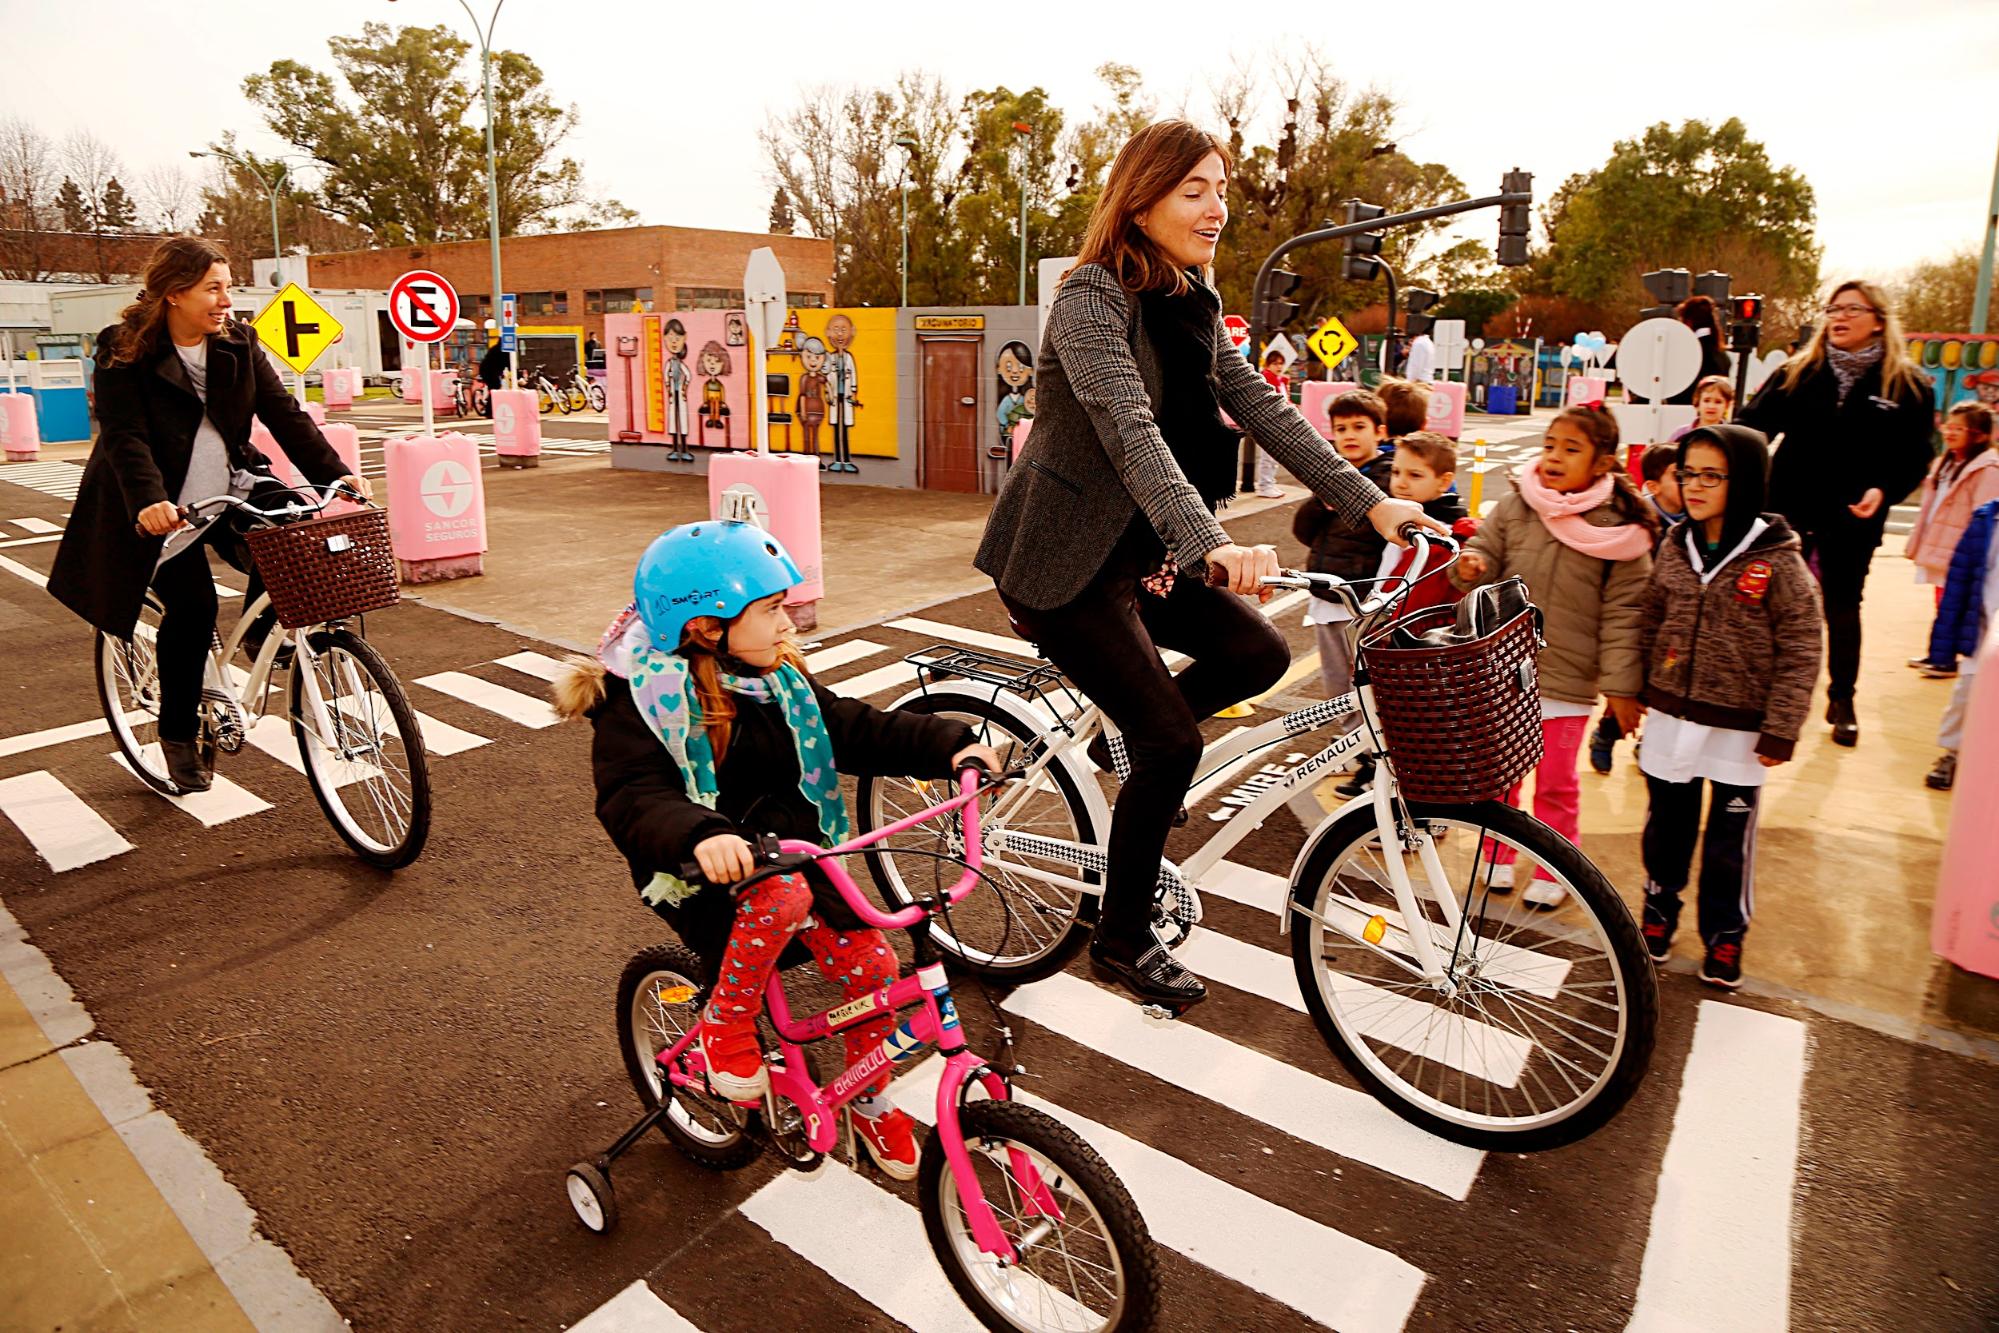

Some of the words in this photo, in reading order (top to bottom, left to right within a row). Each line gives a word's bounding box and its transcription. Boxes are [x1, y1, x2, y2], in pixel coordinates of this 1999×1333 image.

[424, 519, 477, 531] SANCOR
[424, 529, 479, 542] SEGUROS
[1296, 730, 1363, 780] RENAULT
